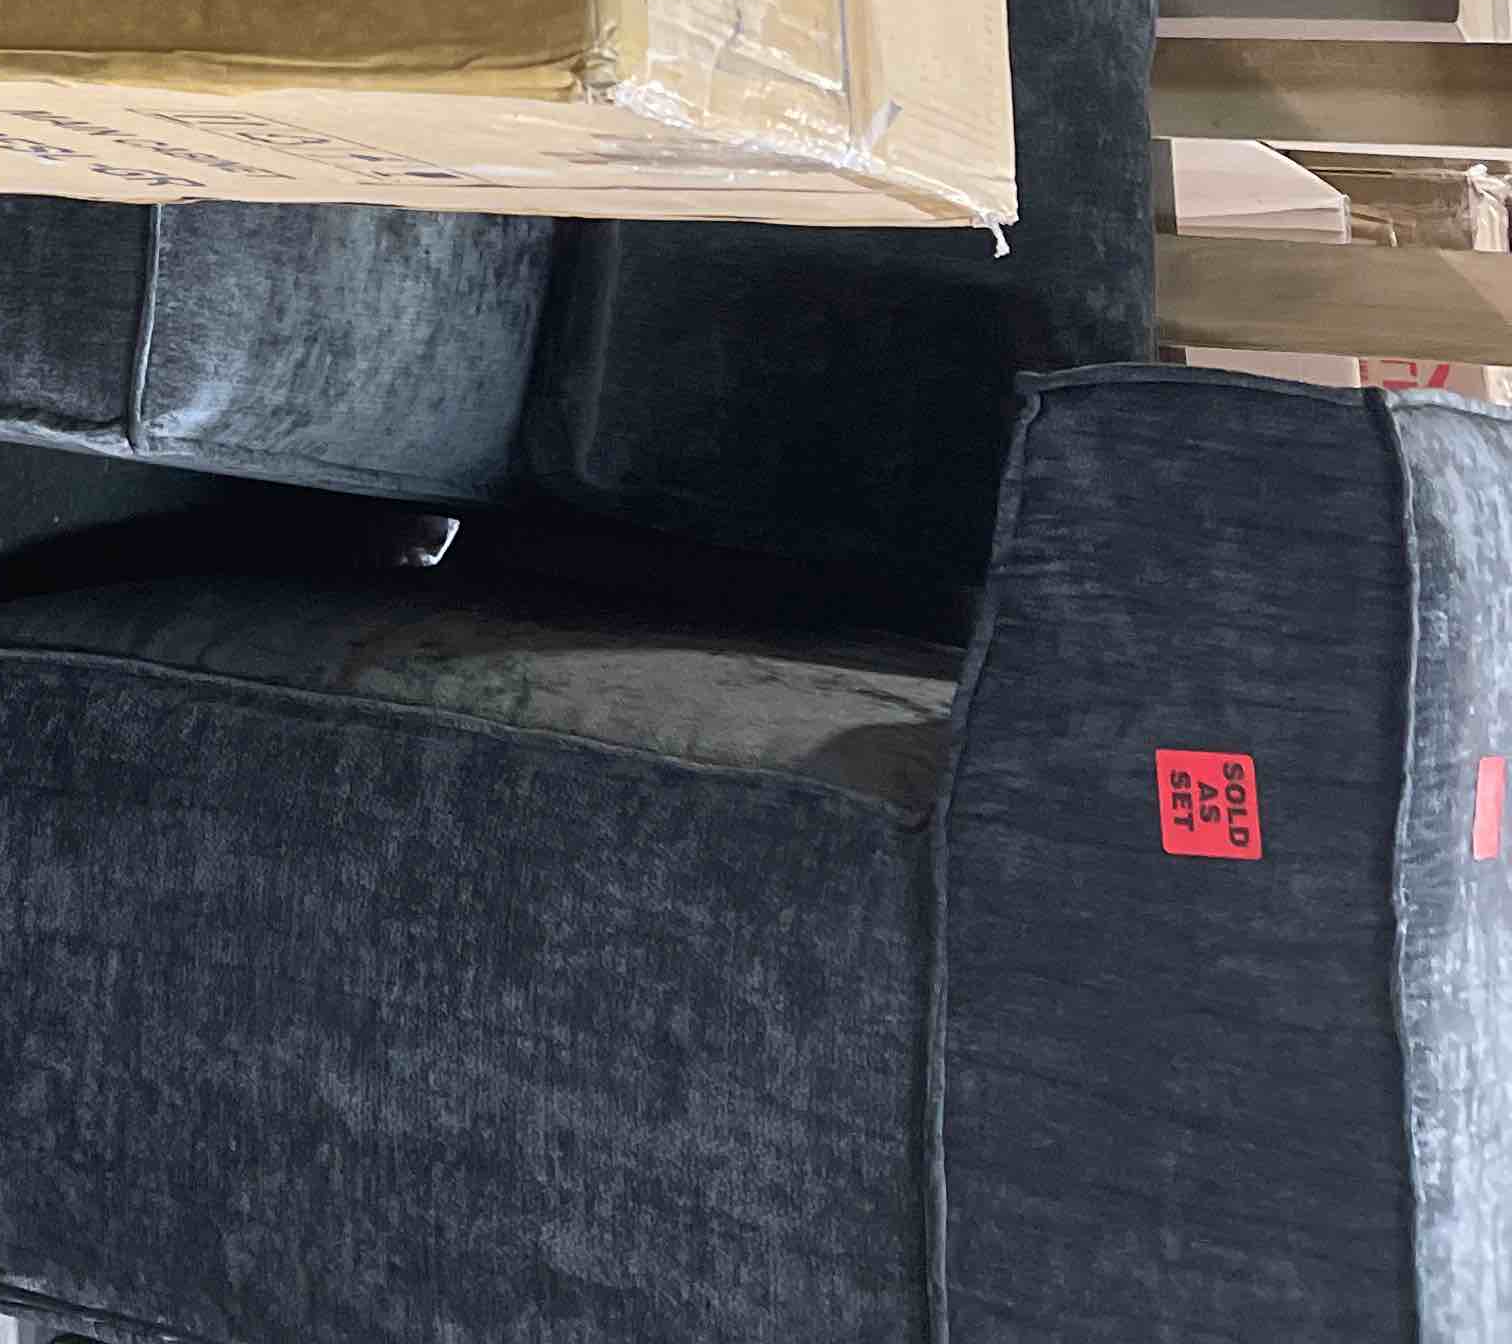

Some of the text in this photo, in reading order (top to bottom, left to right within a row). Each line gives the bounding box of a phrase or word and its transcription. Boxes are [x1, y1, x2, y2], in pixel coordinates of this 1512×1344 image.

[1171, 769, 1195, 832] SET
[1197, 781, 1221, 824] AS
[1223, 762, 1250, 848] SOLD
